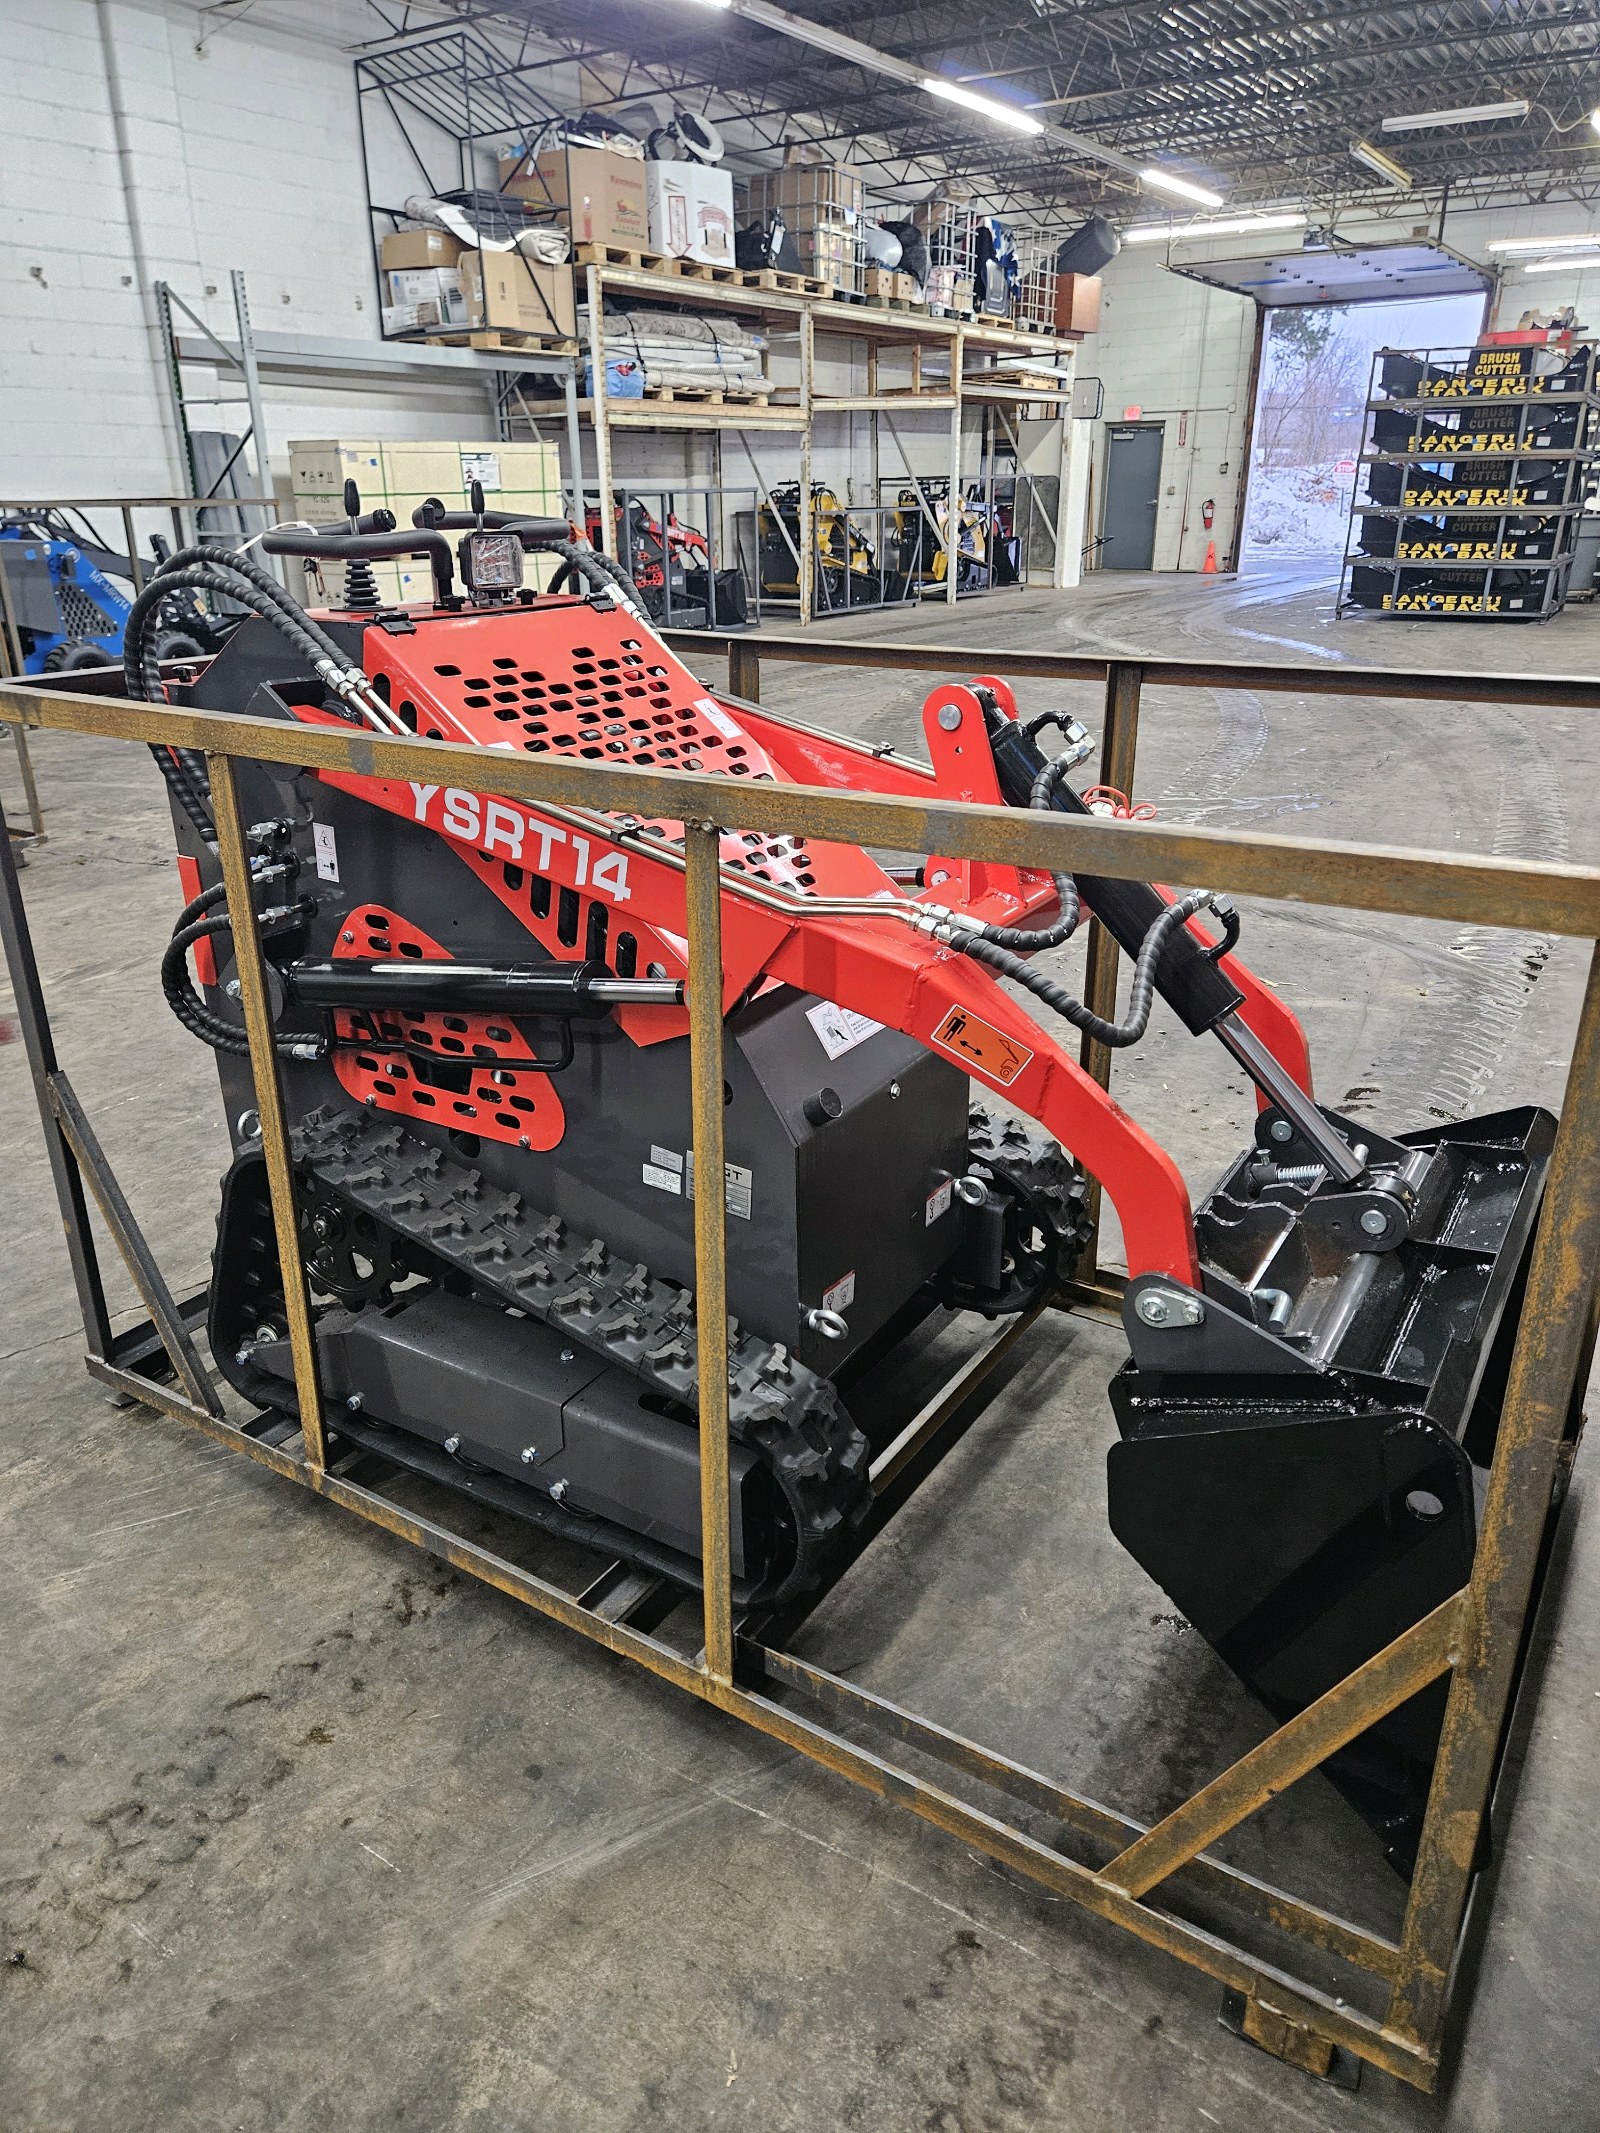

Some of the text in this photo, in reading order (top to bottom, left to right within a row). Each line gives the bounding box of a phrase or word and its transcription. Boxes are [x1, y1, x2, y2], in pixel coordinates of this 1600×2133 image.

[1479, 351, 1521, 365] BRUSH
[1474, 363, 1521, 376] CUTTER
[1416, 384, 1544, 398] STAY BACK
[1473, 407, 1514, 419] BRUSH
[1469, 416, 1515, 429] CUTTER
[1407, 442, 1533, 453] STAY BACK
[1461, 470, 1507, 482] CUTTER
[1403, 497, 1528, 507] STAY BACK
[1452, 521, 1498, 533] CUTTER
[1397, 550, 1516, 560] STAY BACK
[1439, 571, 1484, 583] CUTTER
[1381, 602, 1500, 612] STAY BACK
[408, 781, 632, 902] YSRT14
